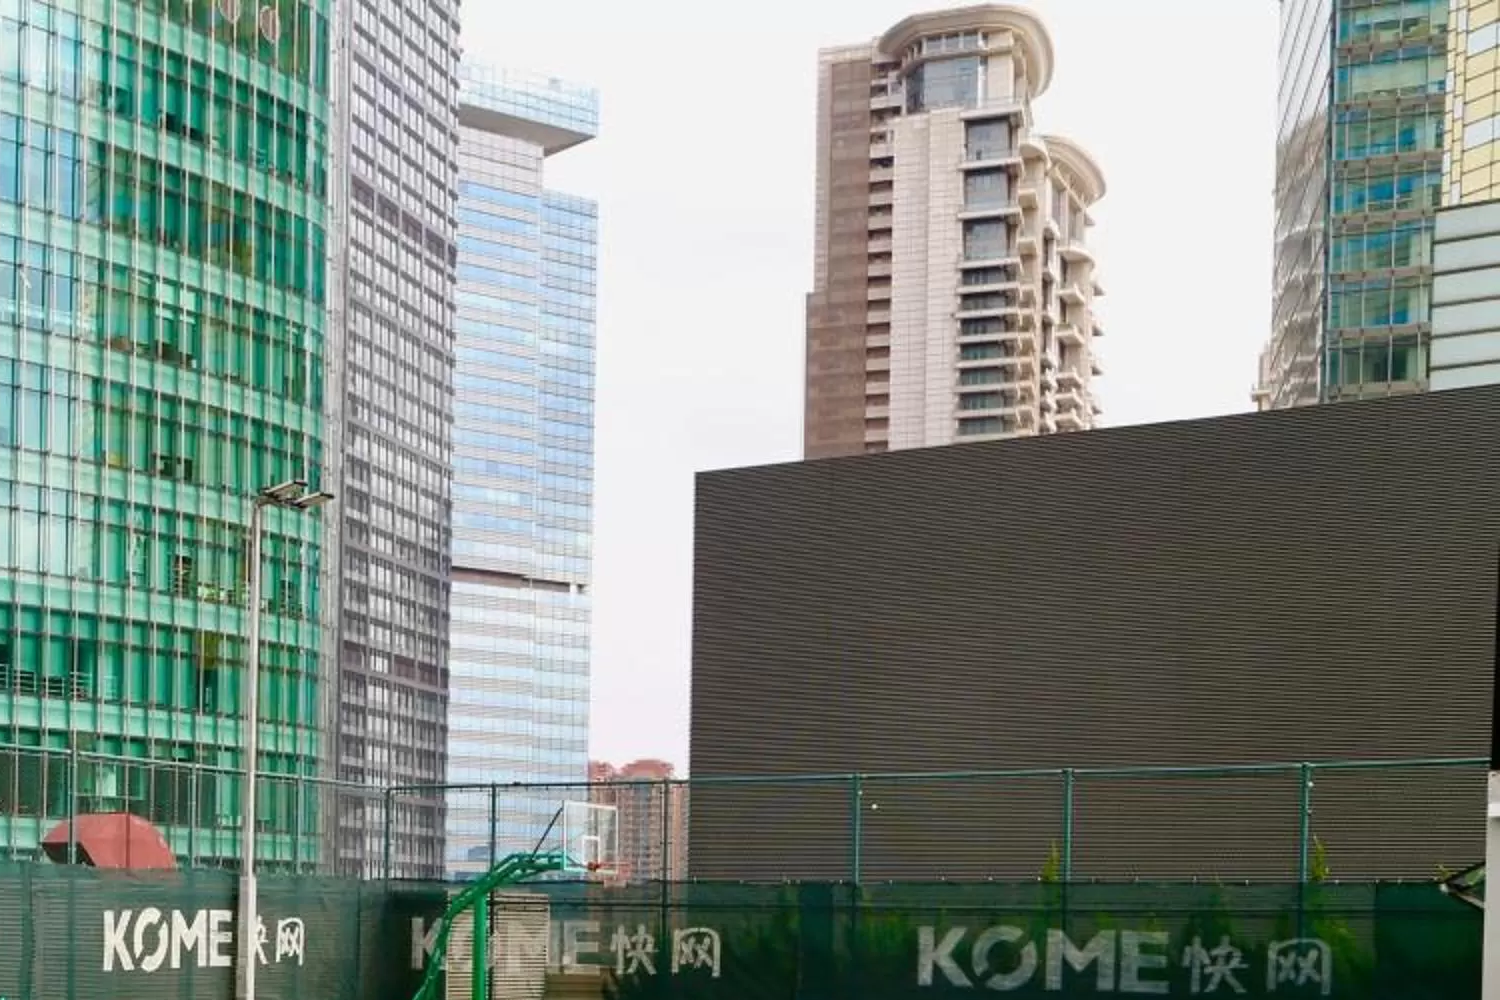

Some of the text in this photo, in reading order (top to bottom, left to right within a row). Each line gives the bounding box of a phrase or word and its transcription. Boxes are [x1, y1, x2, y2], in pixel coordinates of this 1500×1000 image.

[103, 907, 232, 972] KOME
[611, 923, 721, 977] 快网
[917, 926, 1331, 995] KOME 快网
